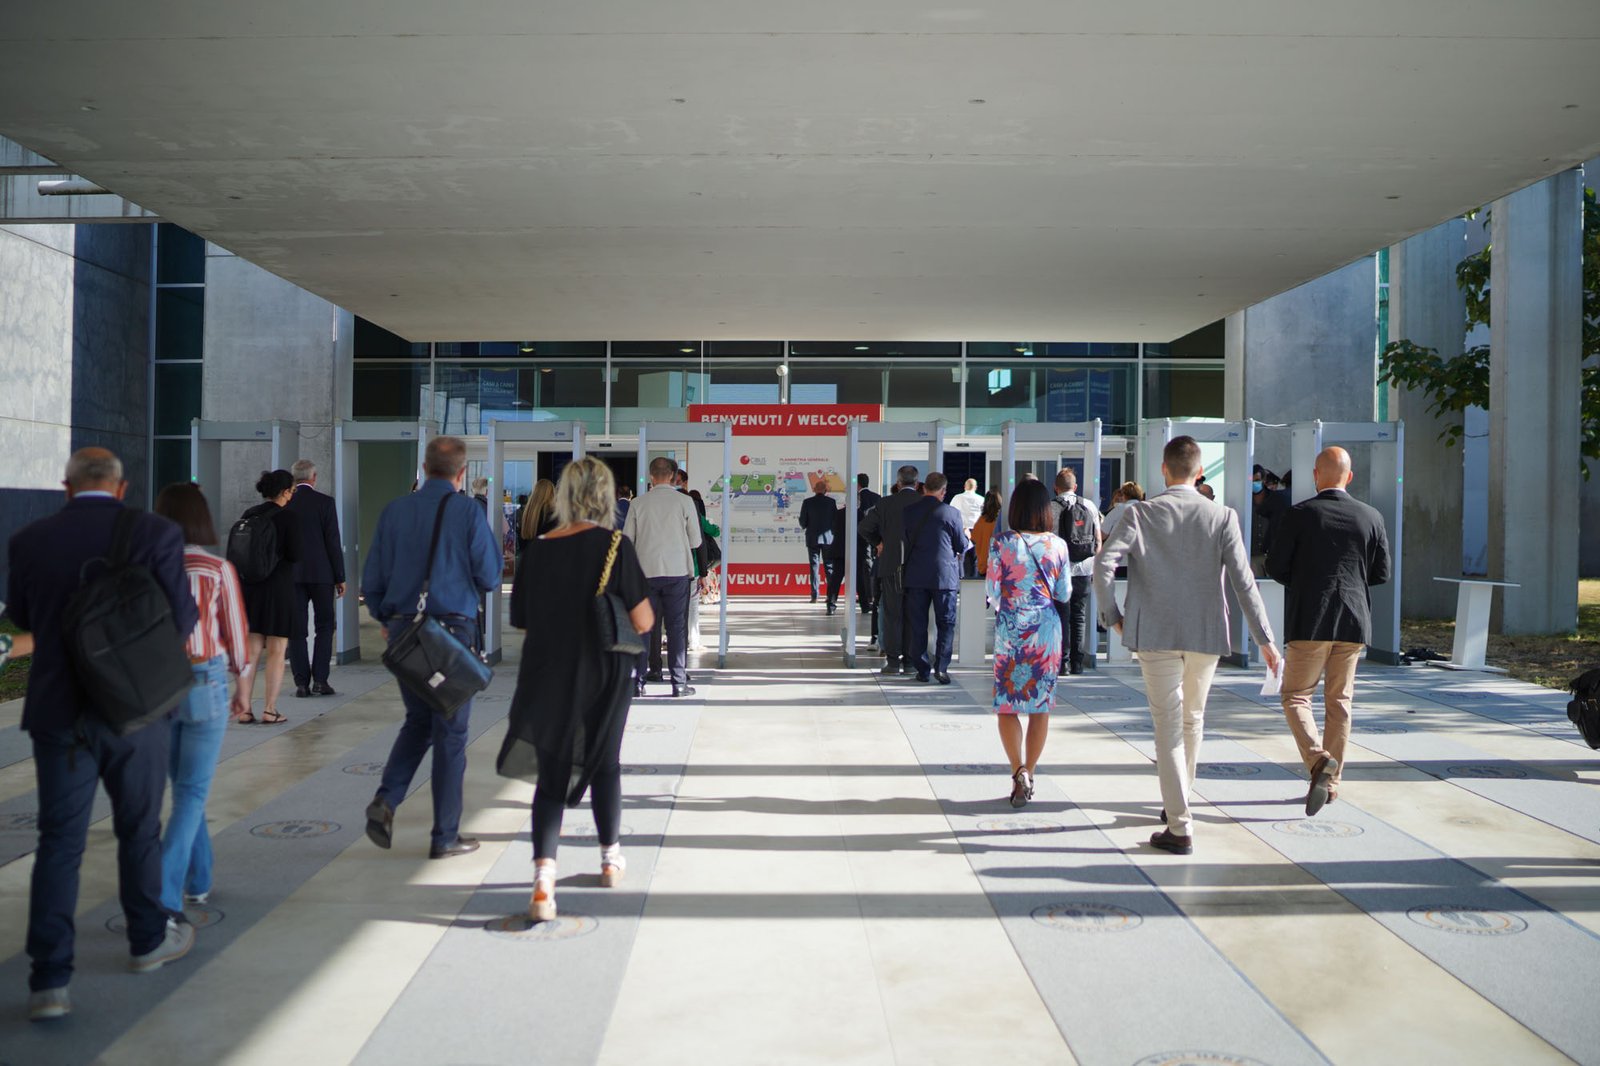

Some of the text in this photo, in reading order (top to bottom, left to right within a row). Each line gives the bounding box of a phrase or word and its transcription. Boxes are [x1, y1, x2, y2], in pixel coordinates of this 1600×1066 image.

[701, 414, 782, 426] BENVENUTI
[797, 414, 868, 426] WELCOME
[717, 574, 779, 585] VENUTI
